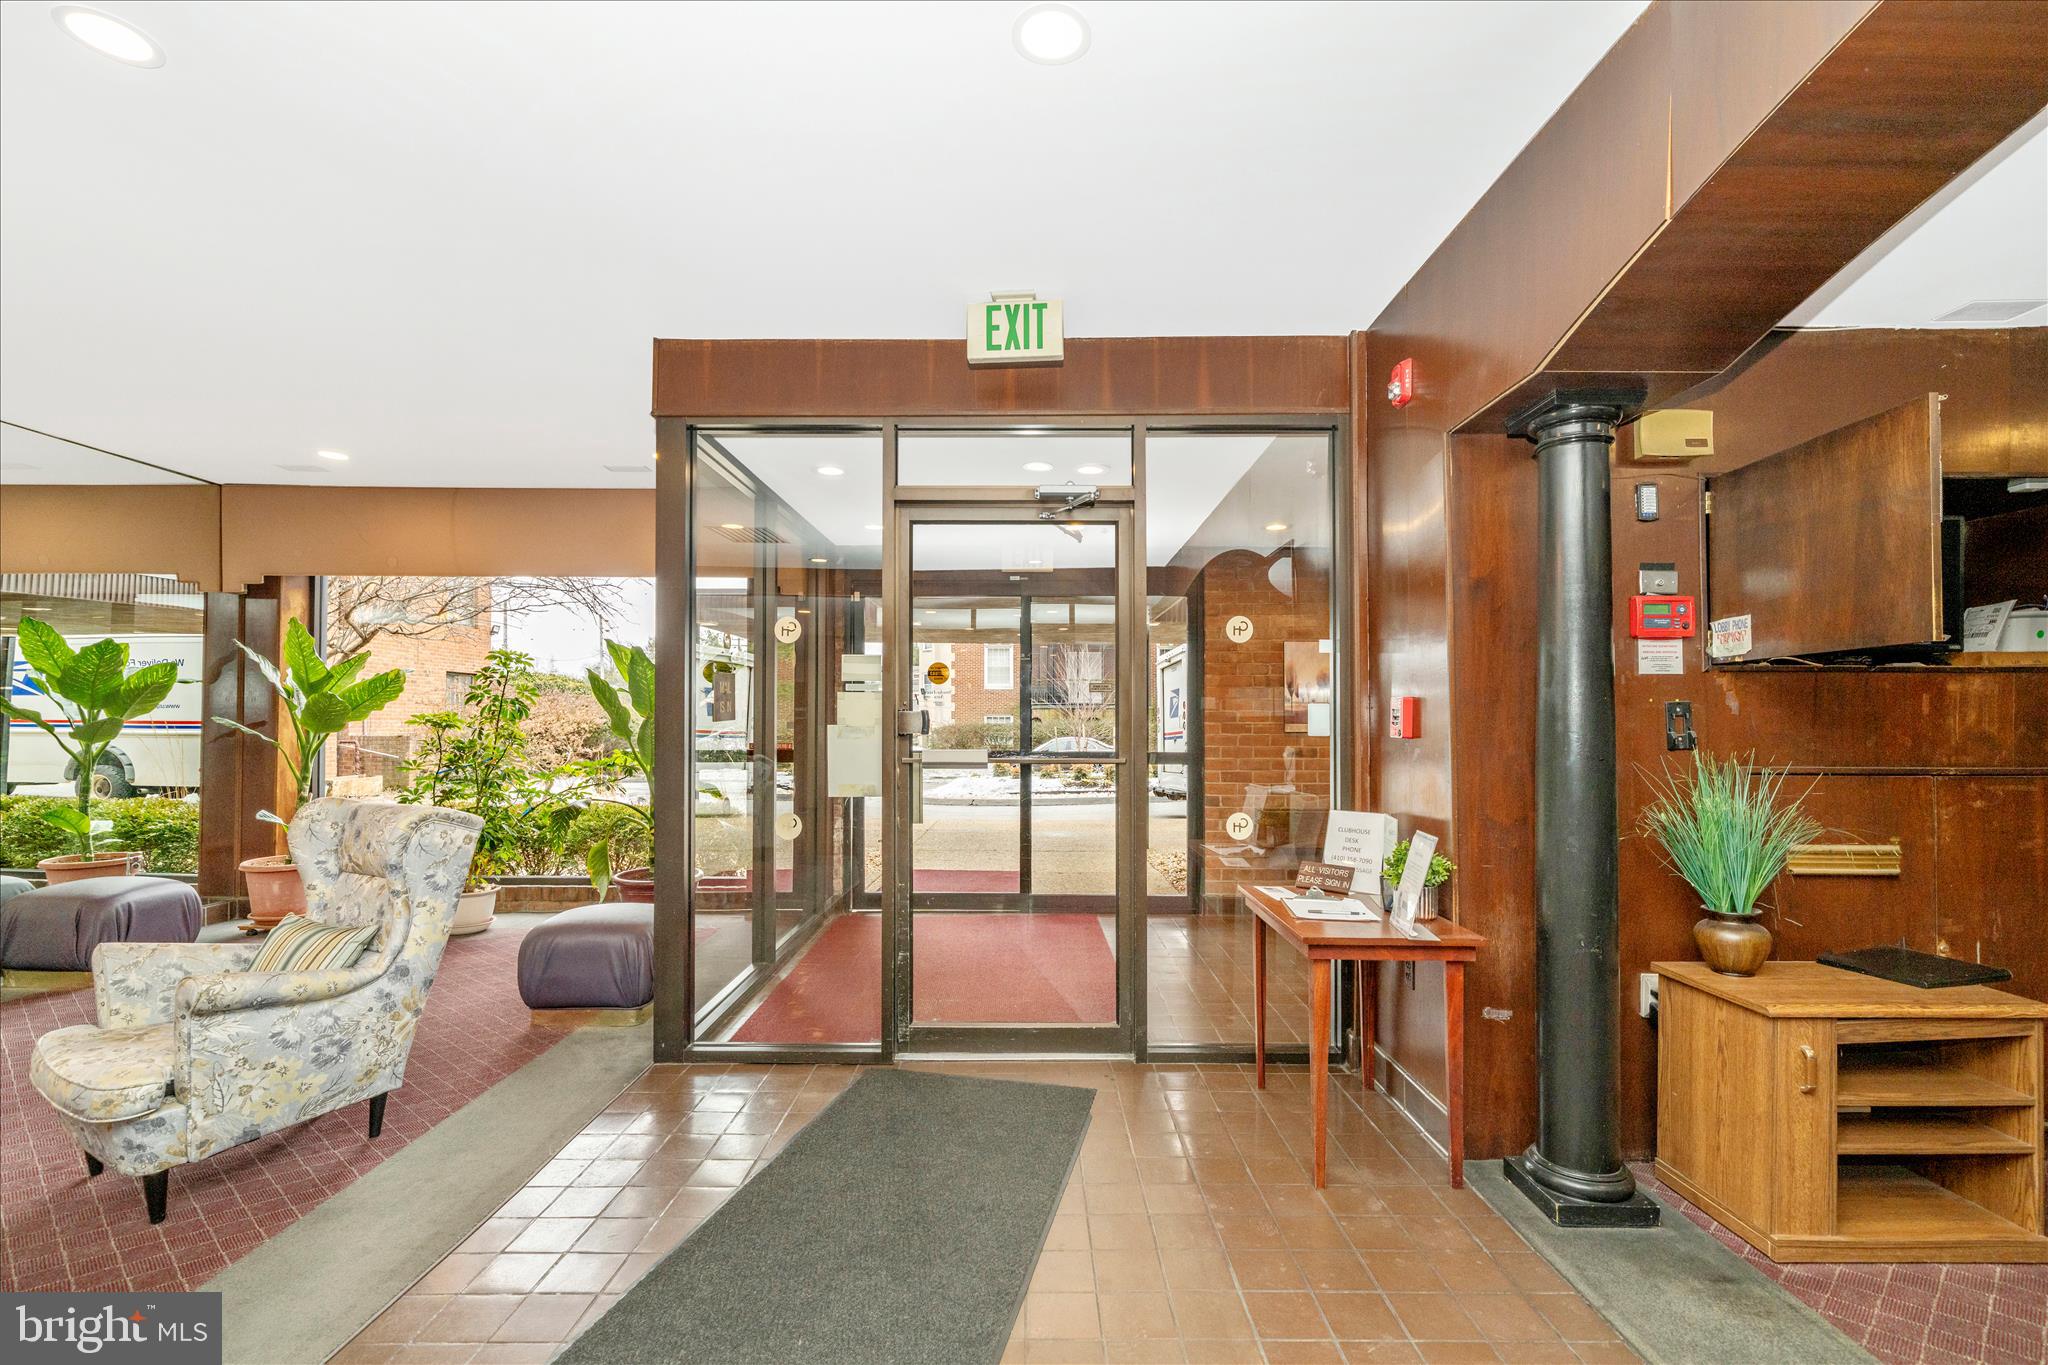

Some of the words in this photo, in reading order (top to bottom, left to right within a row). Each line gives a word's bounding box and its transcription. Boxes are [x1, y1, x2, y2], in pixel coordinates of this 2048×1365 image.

[986, 303, 1048, 351] EXIT
[1337, 826, 1371, 835] CLUBHOUSE
[1303, 864, 1316, 873] ALL
[1319, 867, 1349, 877] VISITORS
[1297, 874, 1323, 885] PLEASE
[1325, 878, 1341, 887] SIGN
[1342, 881, 1350, 889] IN
